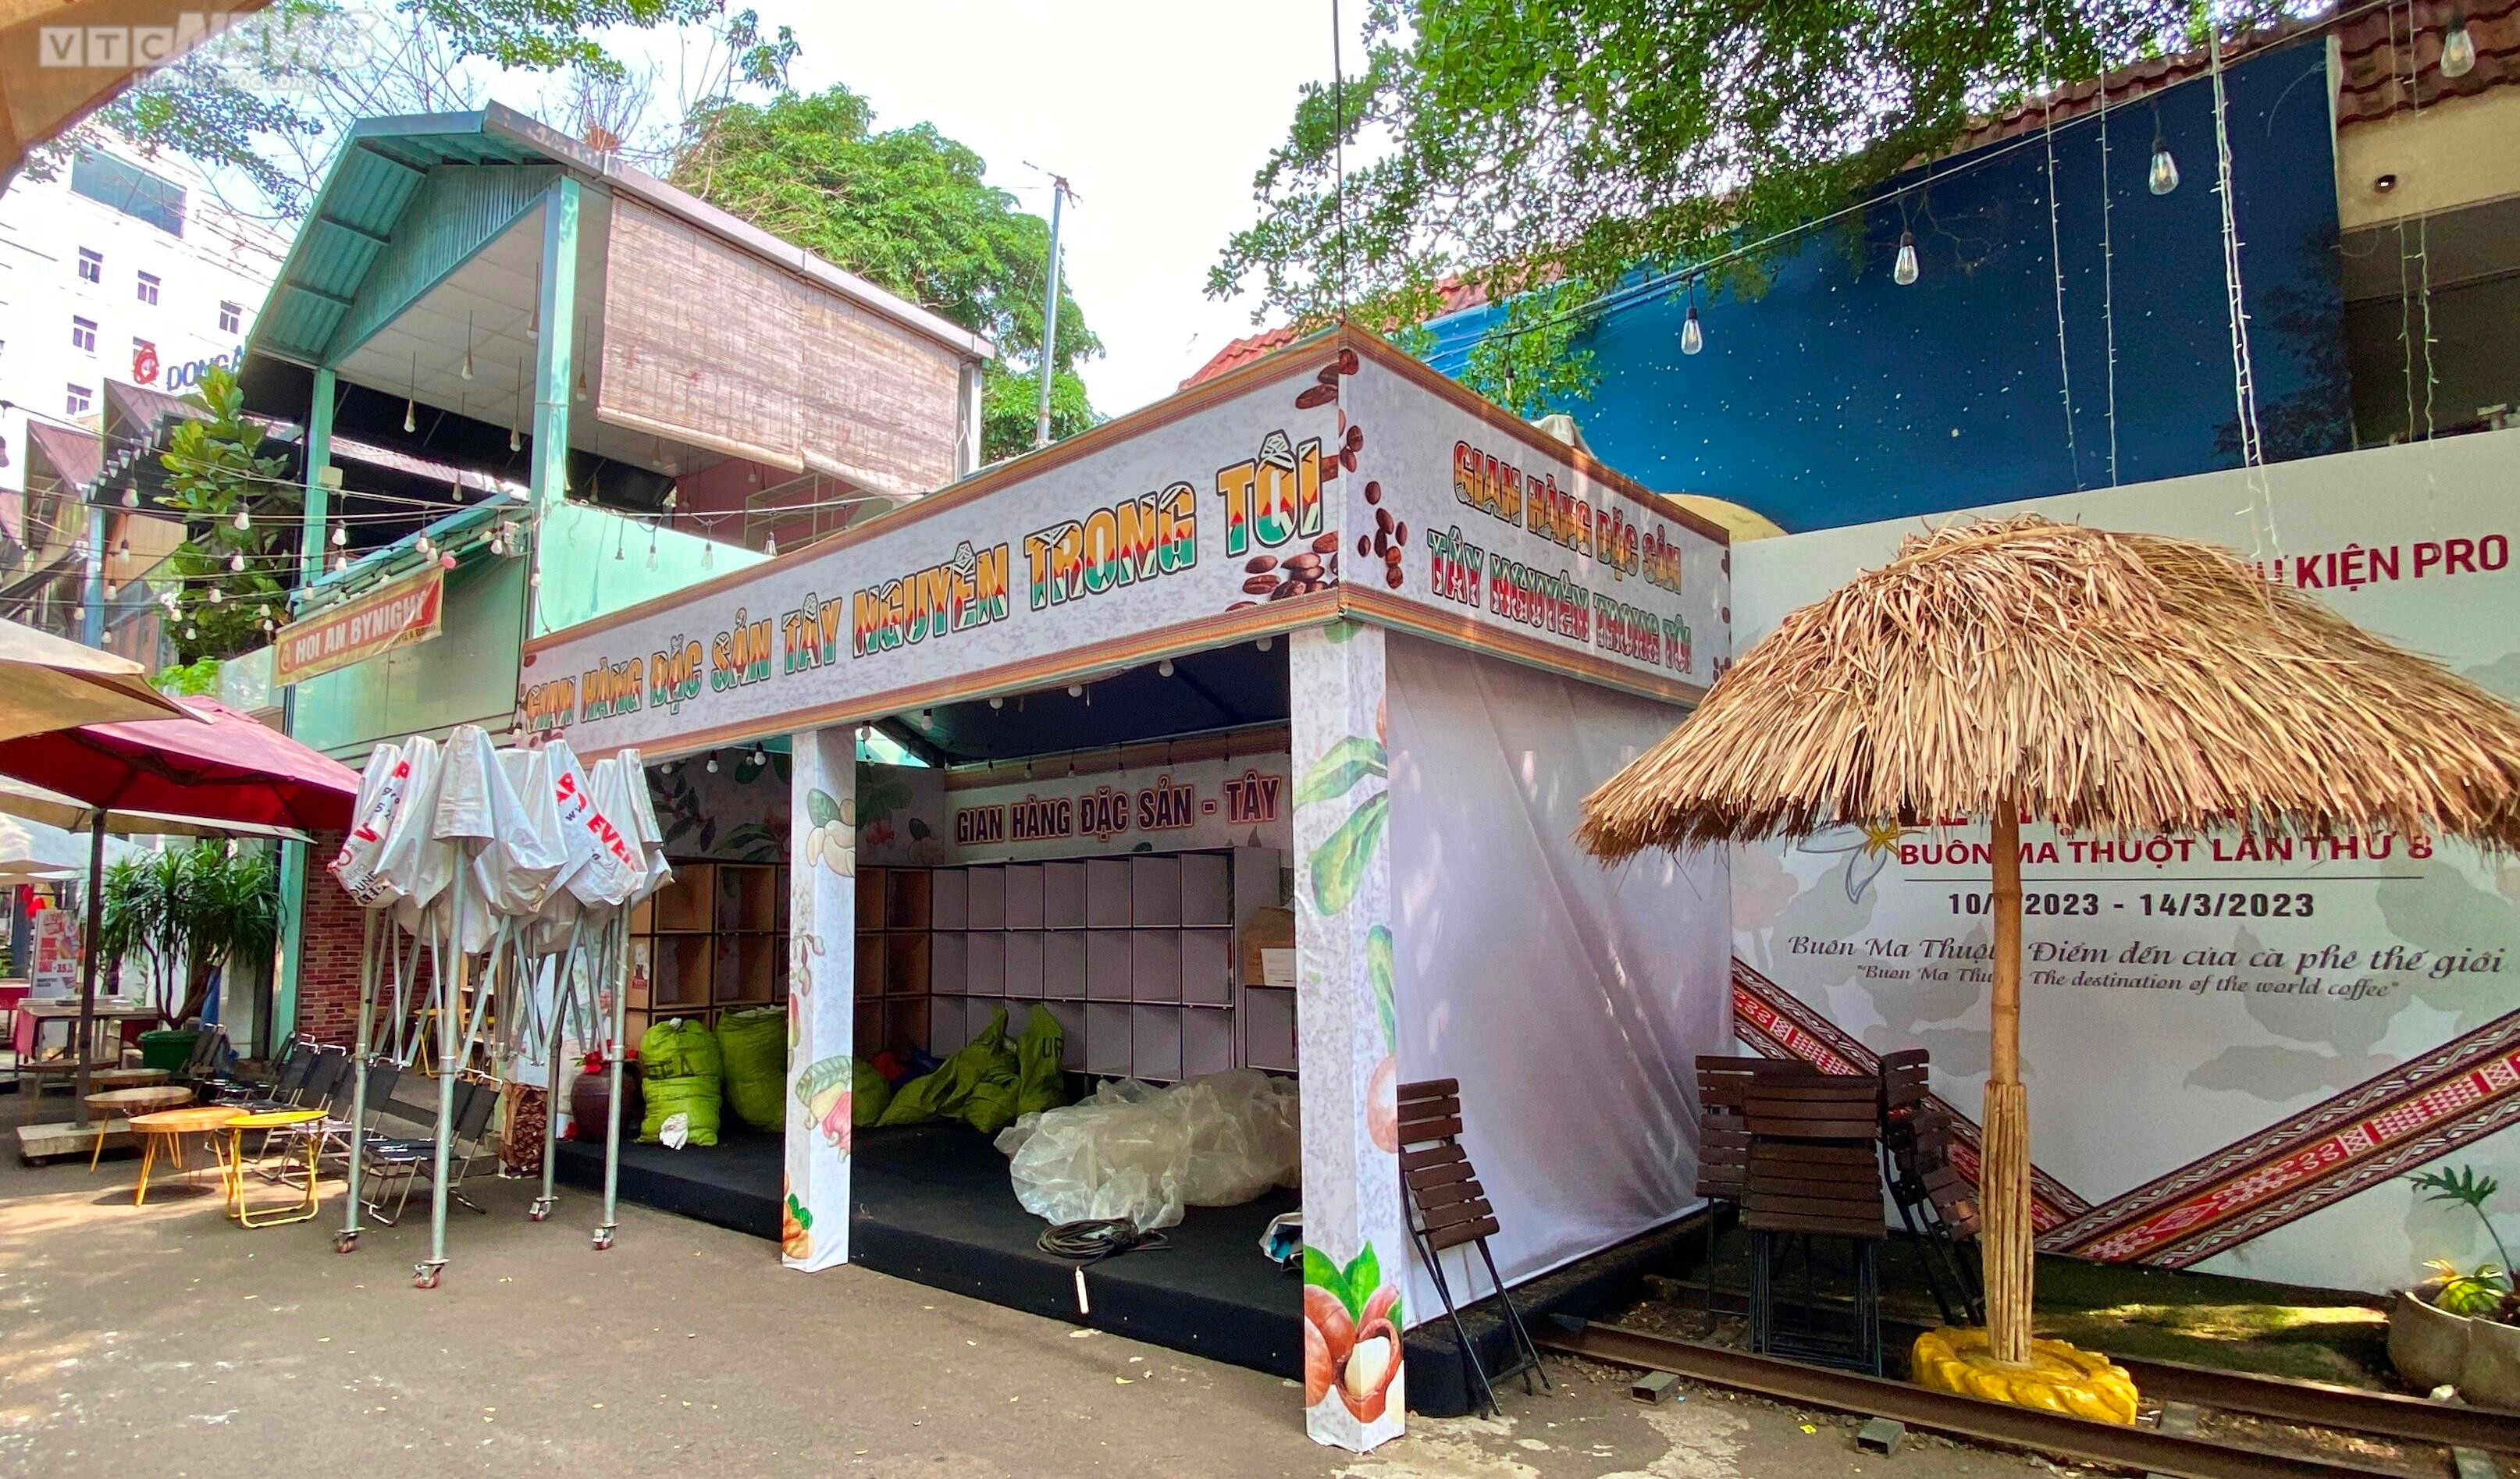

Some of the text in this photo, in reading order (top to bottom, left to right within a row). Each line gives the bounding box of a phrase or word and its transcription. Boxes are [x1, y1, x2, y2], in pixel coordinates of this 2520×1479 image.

[1454, 440, 1682, 595] GIAN HÀNG ĐẶC SẢN
[525, 429, 1321, 734] GIAN HÀNG ĐẶC SẢN TÂY NGUYÊN TRONG TÔI
[2296, 542, 2399, 592] KIỆN
[2414, 534, 2509, 578] PRO
[1427, 525, 1692, 674] TÂY NGUYÊN TRONG TÔI
[295, 631, 320, 663] HOI
[324, 622, 347, 654] AN
[955, 805, 1005, 845] GIAN
[1010, 795, 1073, 841] HÀNG
[1080, 787, 1130, 841] ĐẶC
[1137, 775, 1194, 829] SẢN
[1225, 770, 1280, 824] TÂY
[1900, 839, 1992, 865] BUÔN
[2067, 835, 2195, 869] THUỘT
[2408, 834, 2433, 860] 8
[2140, 893, 2315, 917] 14/3/2023
[1788, 935, 1855, 957] Buôn
[1865, 937, 1910, 958] Ma
[2118, 940, 2174, 965] đến
[2182, 946, 2241, 968] của
[2249, 947, 2287, 969] cà
[2295, 944, 2360, 975] phê
[2369, 944, 2431, 971] thế
[1917, 966, 1949, 982] Ma
[2030, 969, 2067, 986] The
[2070, 970, 2185, 990] destination
[2188, 973, 2214, 994] of
[2216, 974, 2250, 993] the
[2255, 978, 2320, 997] world
